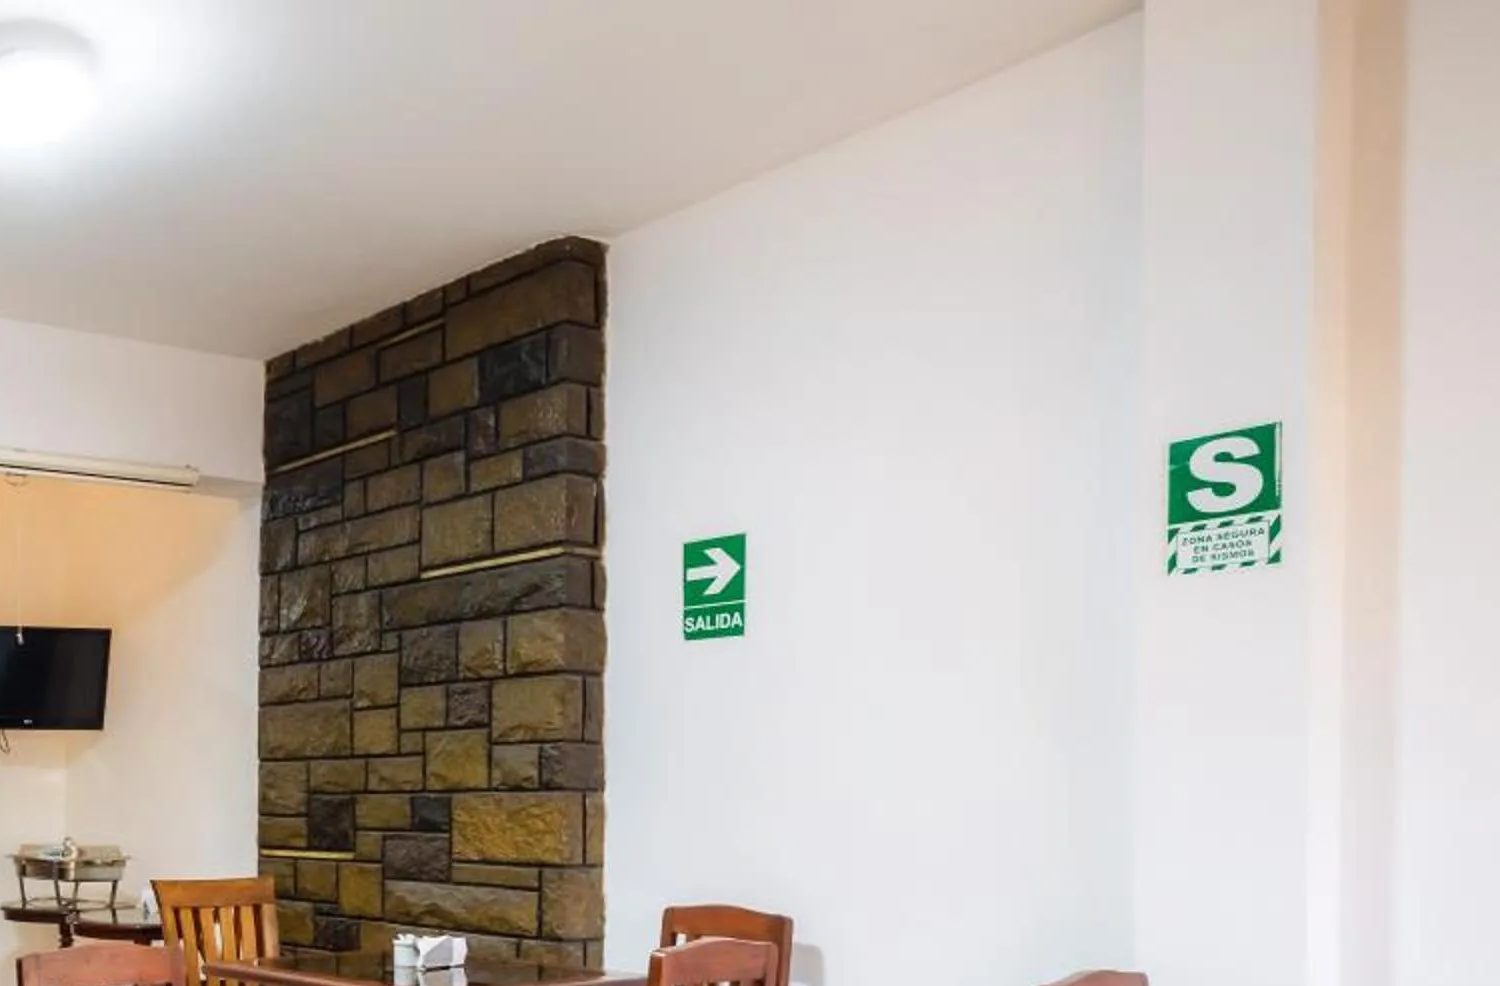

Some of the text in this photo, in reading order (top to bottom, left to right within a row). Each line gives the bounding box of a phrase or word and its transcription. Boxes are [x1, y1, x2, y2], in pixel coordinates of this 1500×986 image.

[1186, 436, 1264, 513] S
[1182, 528, 1264, 546] ZONA SEGURA
[1193, 545, 1208, 554] EN
[1211, 550, 1254, 561] SISMOS
[685, 612, 743, 633] SALIDA
